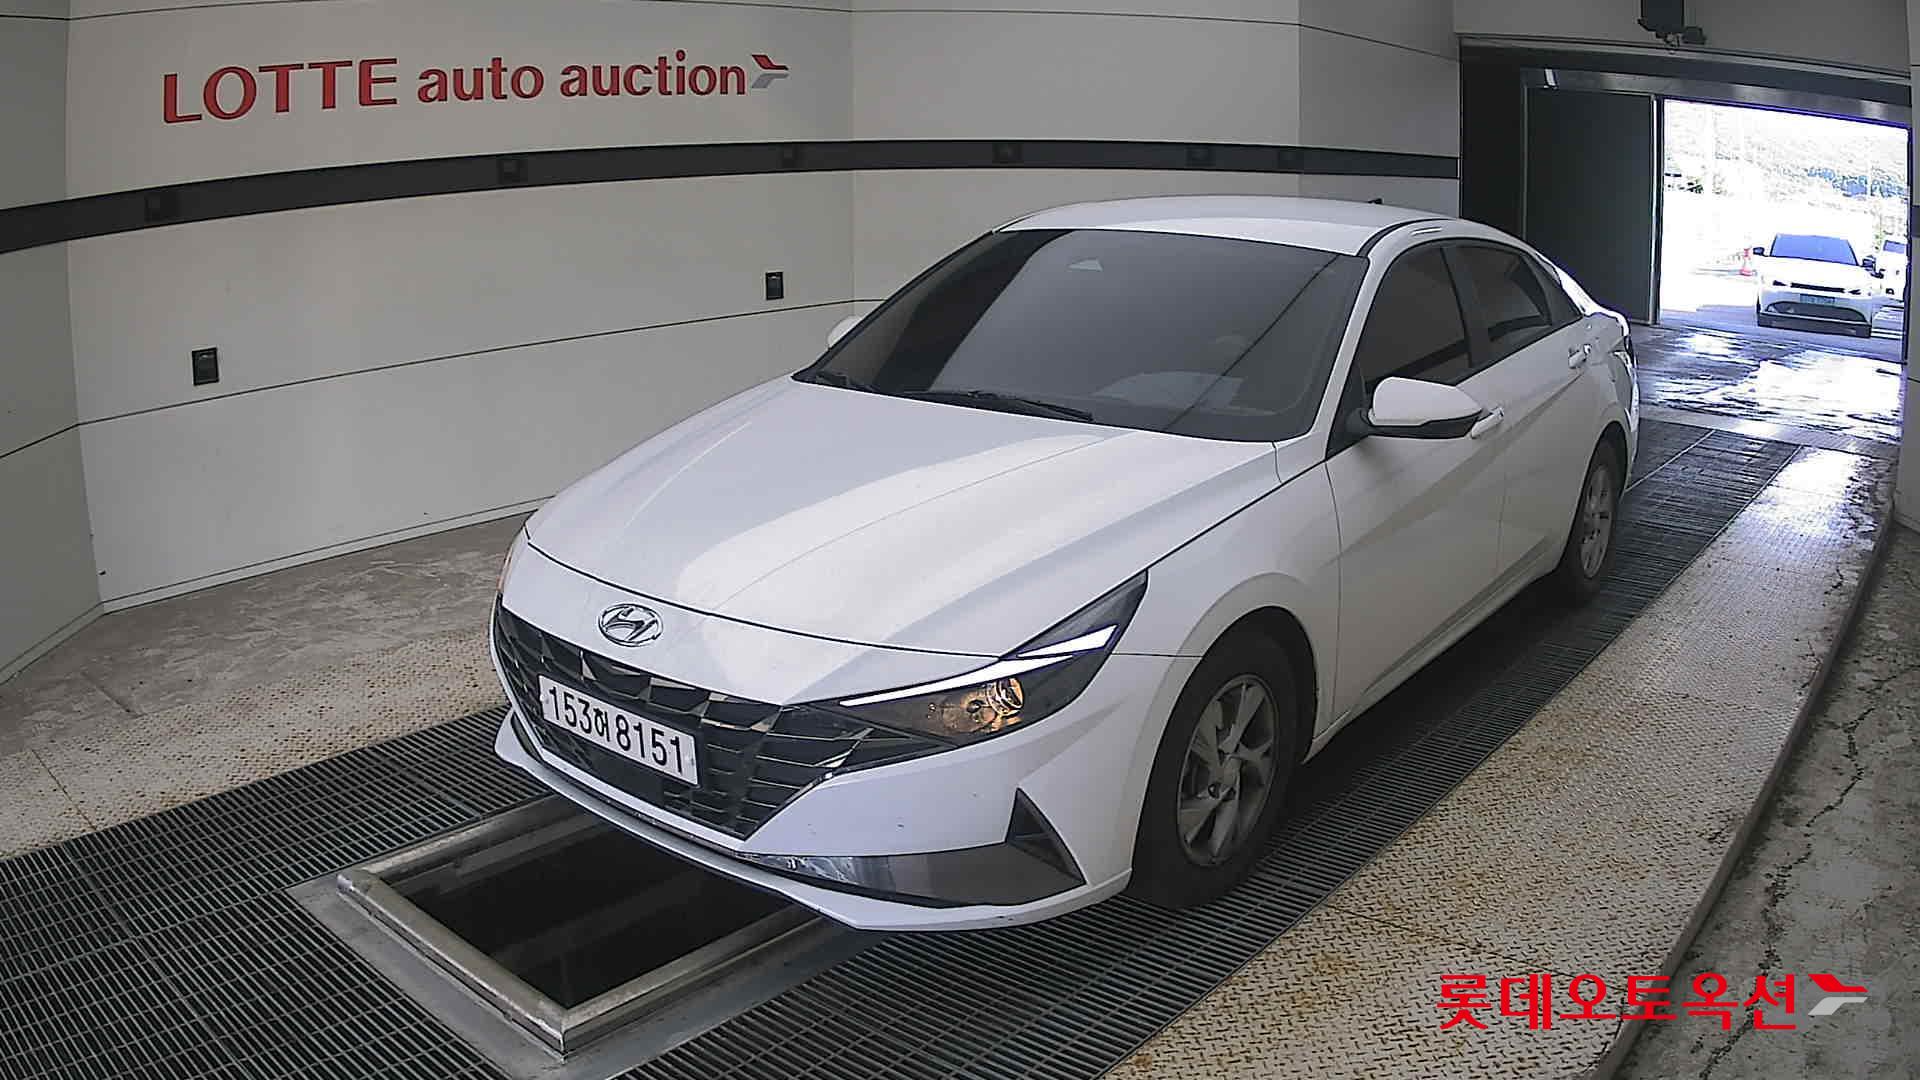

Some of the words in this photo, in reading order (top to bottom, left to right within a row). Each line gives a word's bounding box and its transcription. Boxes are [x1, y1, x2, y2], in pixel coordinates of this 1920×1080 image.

[163, 58, 398, 124] LOTTE
[417, 57, 545, 103] auto
[560, 50, 746, 97] auction
